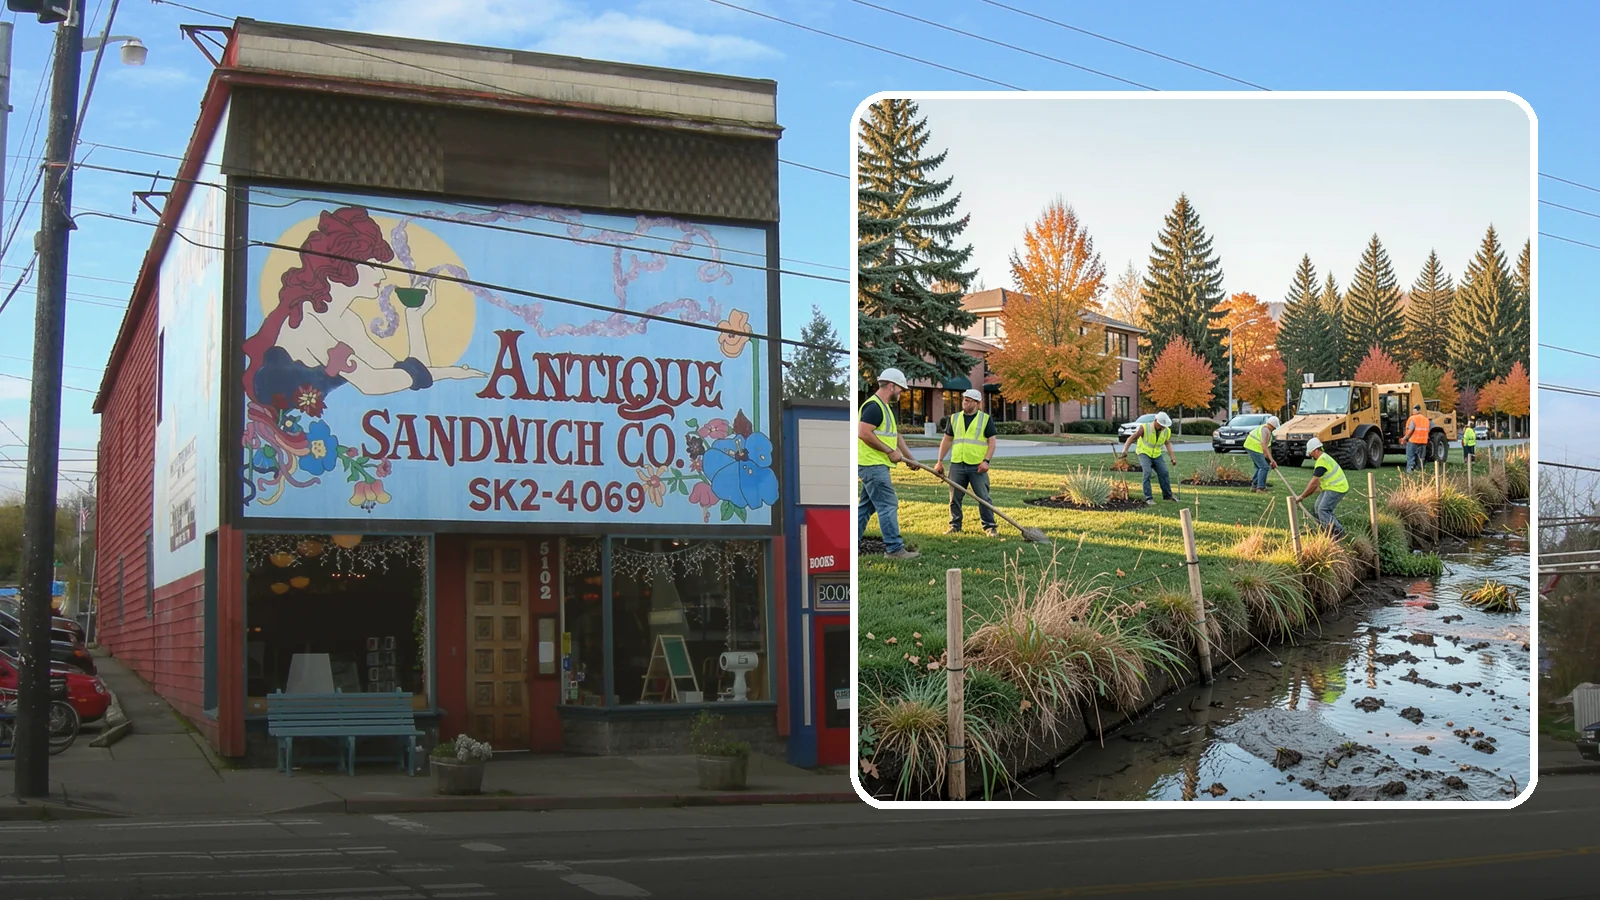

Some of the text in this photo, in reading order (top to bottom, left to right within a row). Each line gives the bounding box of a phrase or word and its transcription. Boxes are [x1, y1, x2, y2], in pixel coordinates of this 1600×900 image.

[476, 329, 723, 421] ANTIQUE
[361, 408, 685, 469] SANDWICH CO.
[468, 477, 646, 513] SK2-4069
[540, 541, 552, 600] 5102
[809, 555, 835, 569] BOOKS
